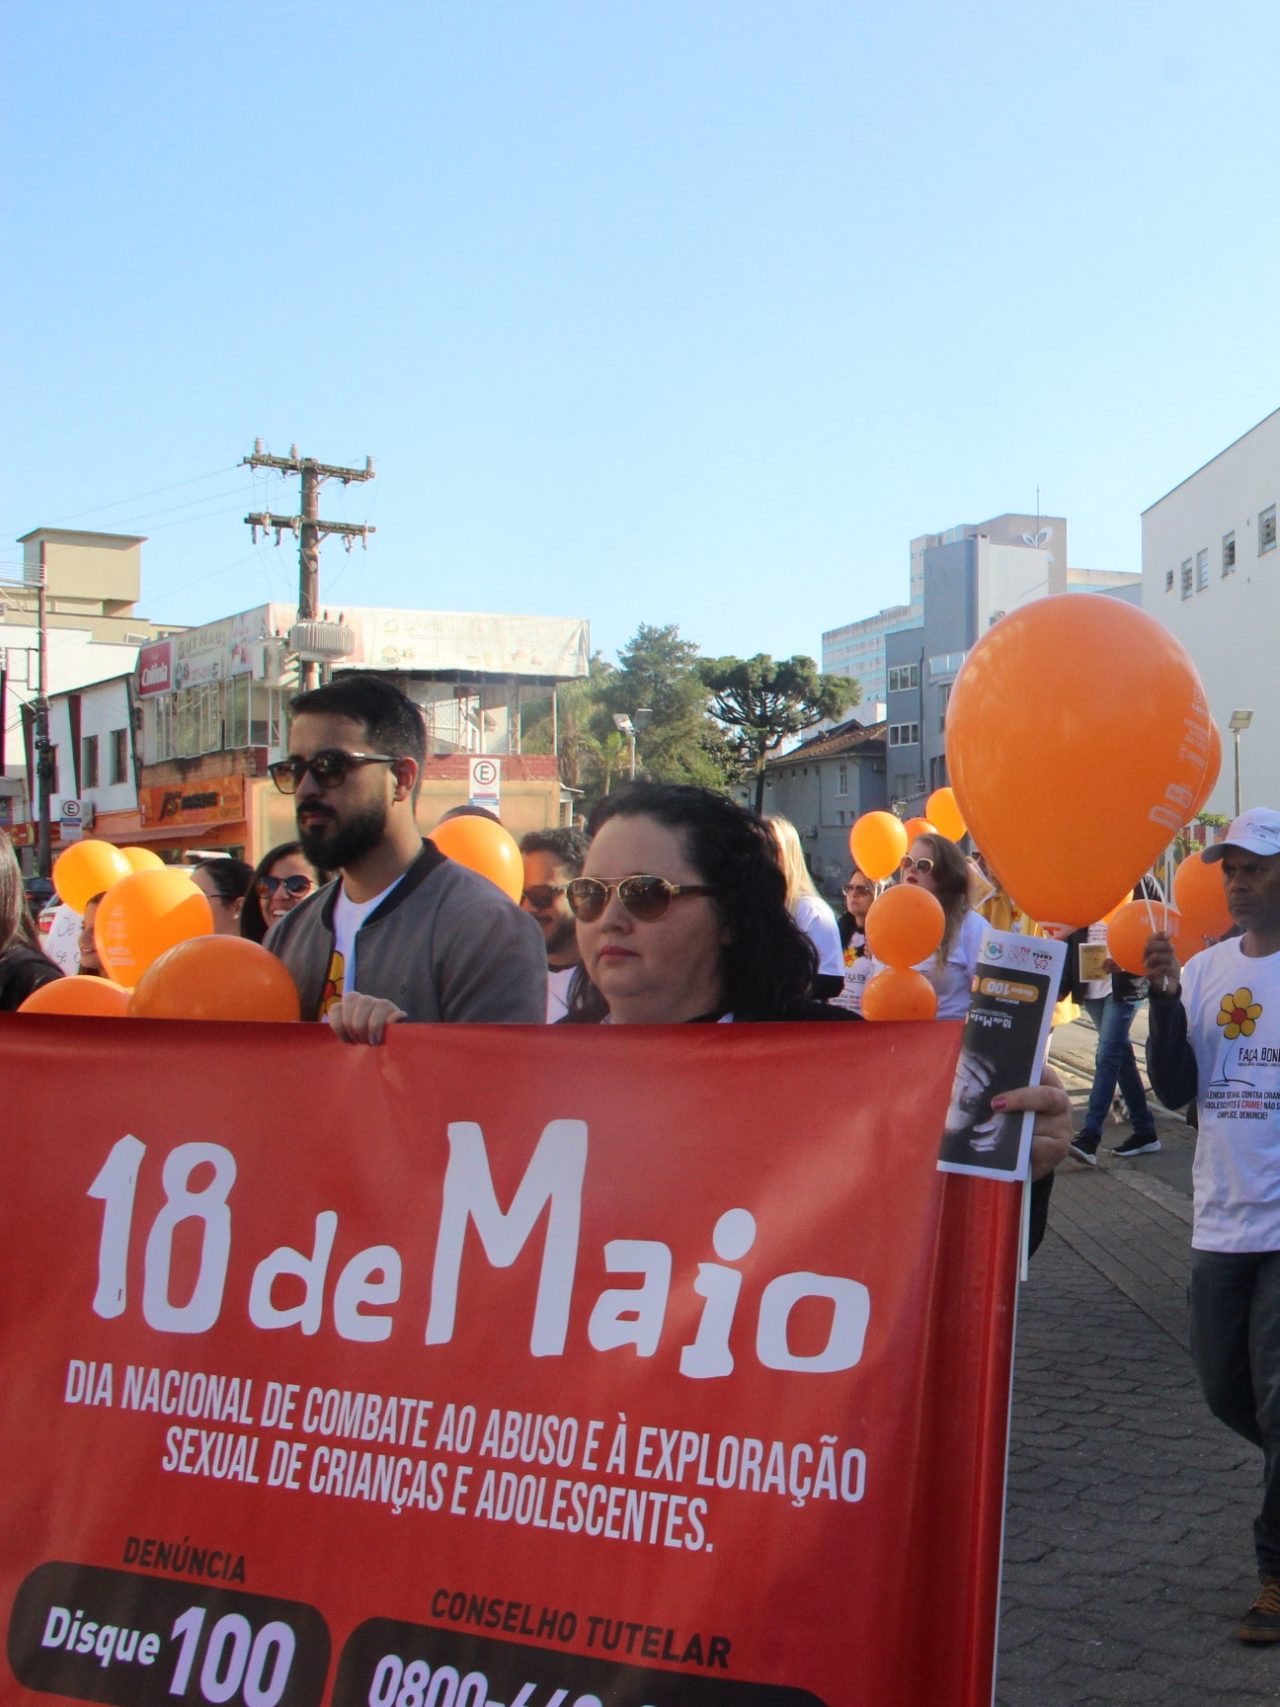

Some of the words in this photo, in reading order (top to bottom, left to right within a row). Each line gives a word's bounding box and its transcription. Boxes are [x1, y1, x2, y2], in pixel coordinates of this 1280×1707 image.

[987, 981, 1010, 995] 100
[1002, 1020, 1012, 1029] 18
[1239, 1047, 1258, 1063] FAÇA
[1264, 1101, 1275, 1109] NÃO
[86, 1133, 237, 1335] 18
[249, 1209, 402, 1342] de
[425, 1119, 871, 1379] Maio
[65, 1360, 113, 1407] DIA
[121, 1365, 253, 1424] NACIONAL
[260, 1381, 300, 1430] DE
[302, 1386, 433, 1448] COMBATE
[434, 1403, 476, 1454] AO
[479, 1408, 578, 1467] ABUSO
[582, 1420, 604, 1471] E
[605, 1412, 627, 1475] À
[635, 1426, 867, 1507] EXPLORAÇÃO
[162, 1425, 259, 1483] SEXUAL
[267, 1440, 307, 1490] DE
[309, 1446, 447, 1514] CRIANÇAS
[451, 1466, 473, 1514] E
[475, 1470, 714, 1553] ADOLESCENTES.
[122, 1536, 246, 1584] DENÚNCIA
[41, 1606, 161, 1668] Disque
[169, 1606, 296, 1707] 100
[431, 1588, 577, 1642] CONSELHO
[586, 1616, 732, 1669] TUTELAR
